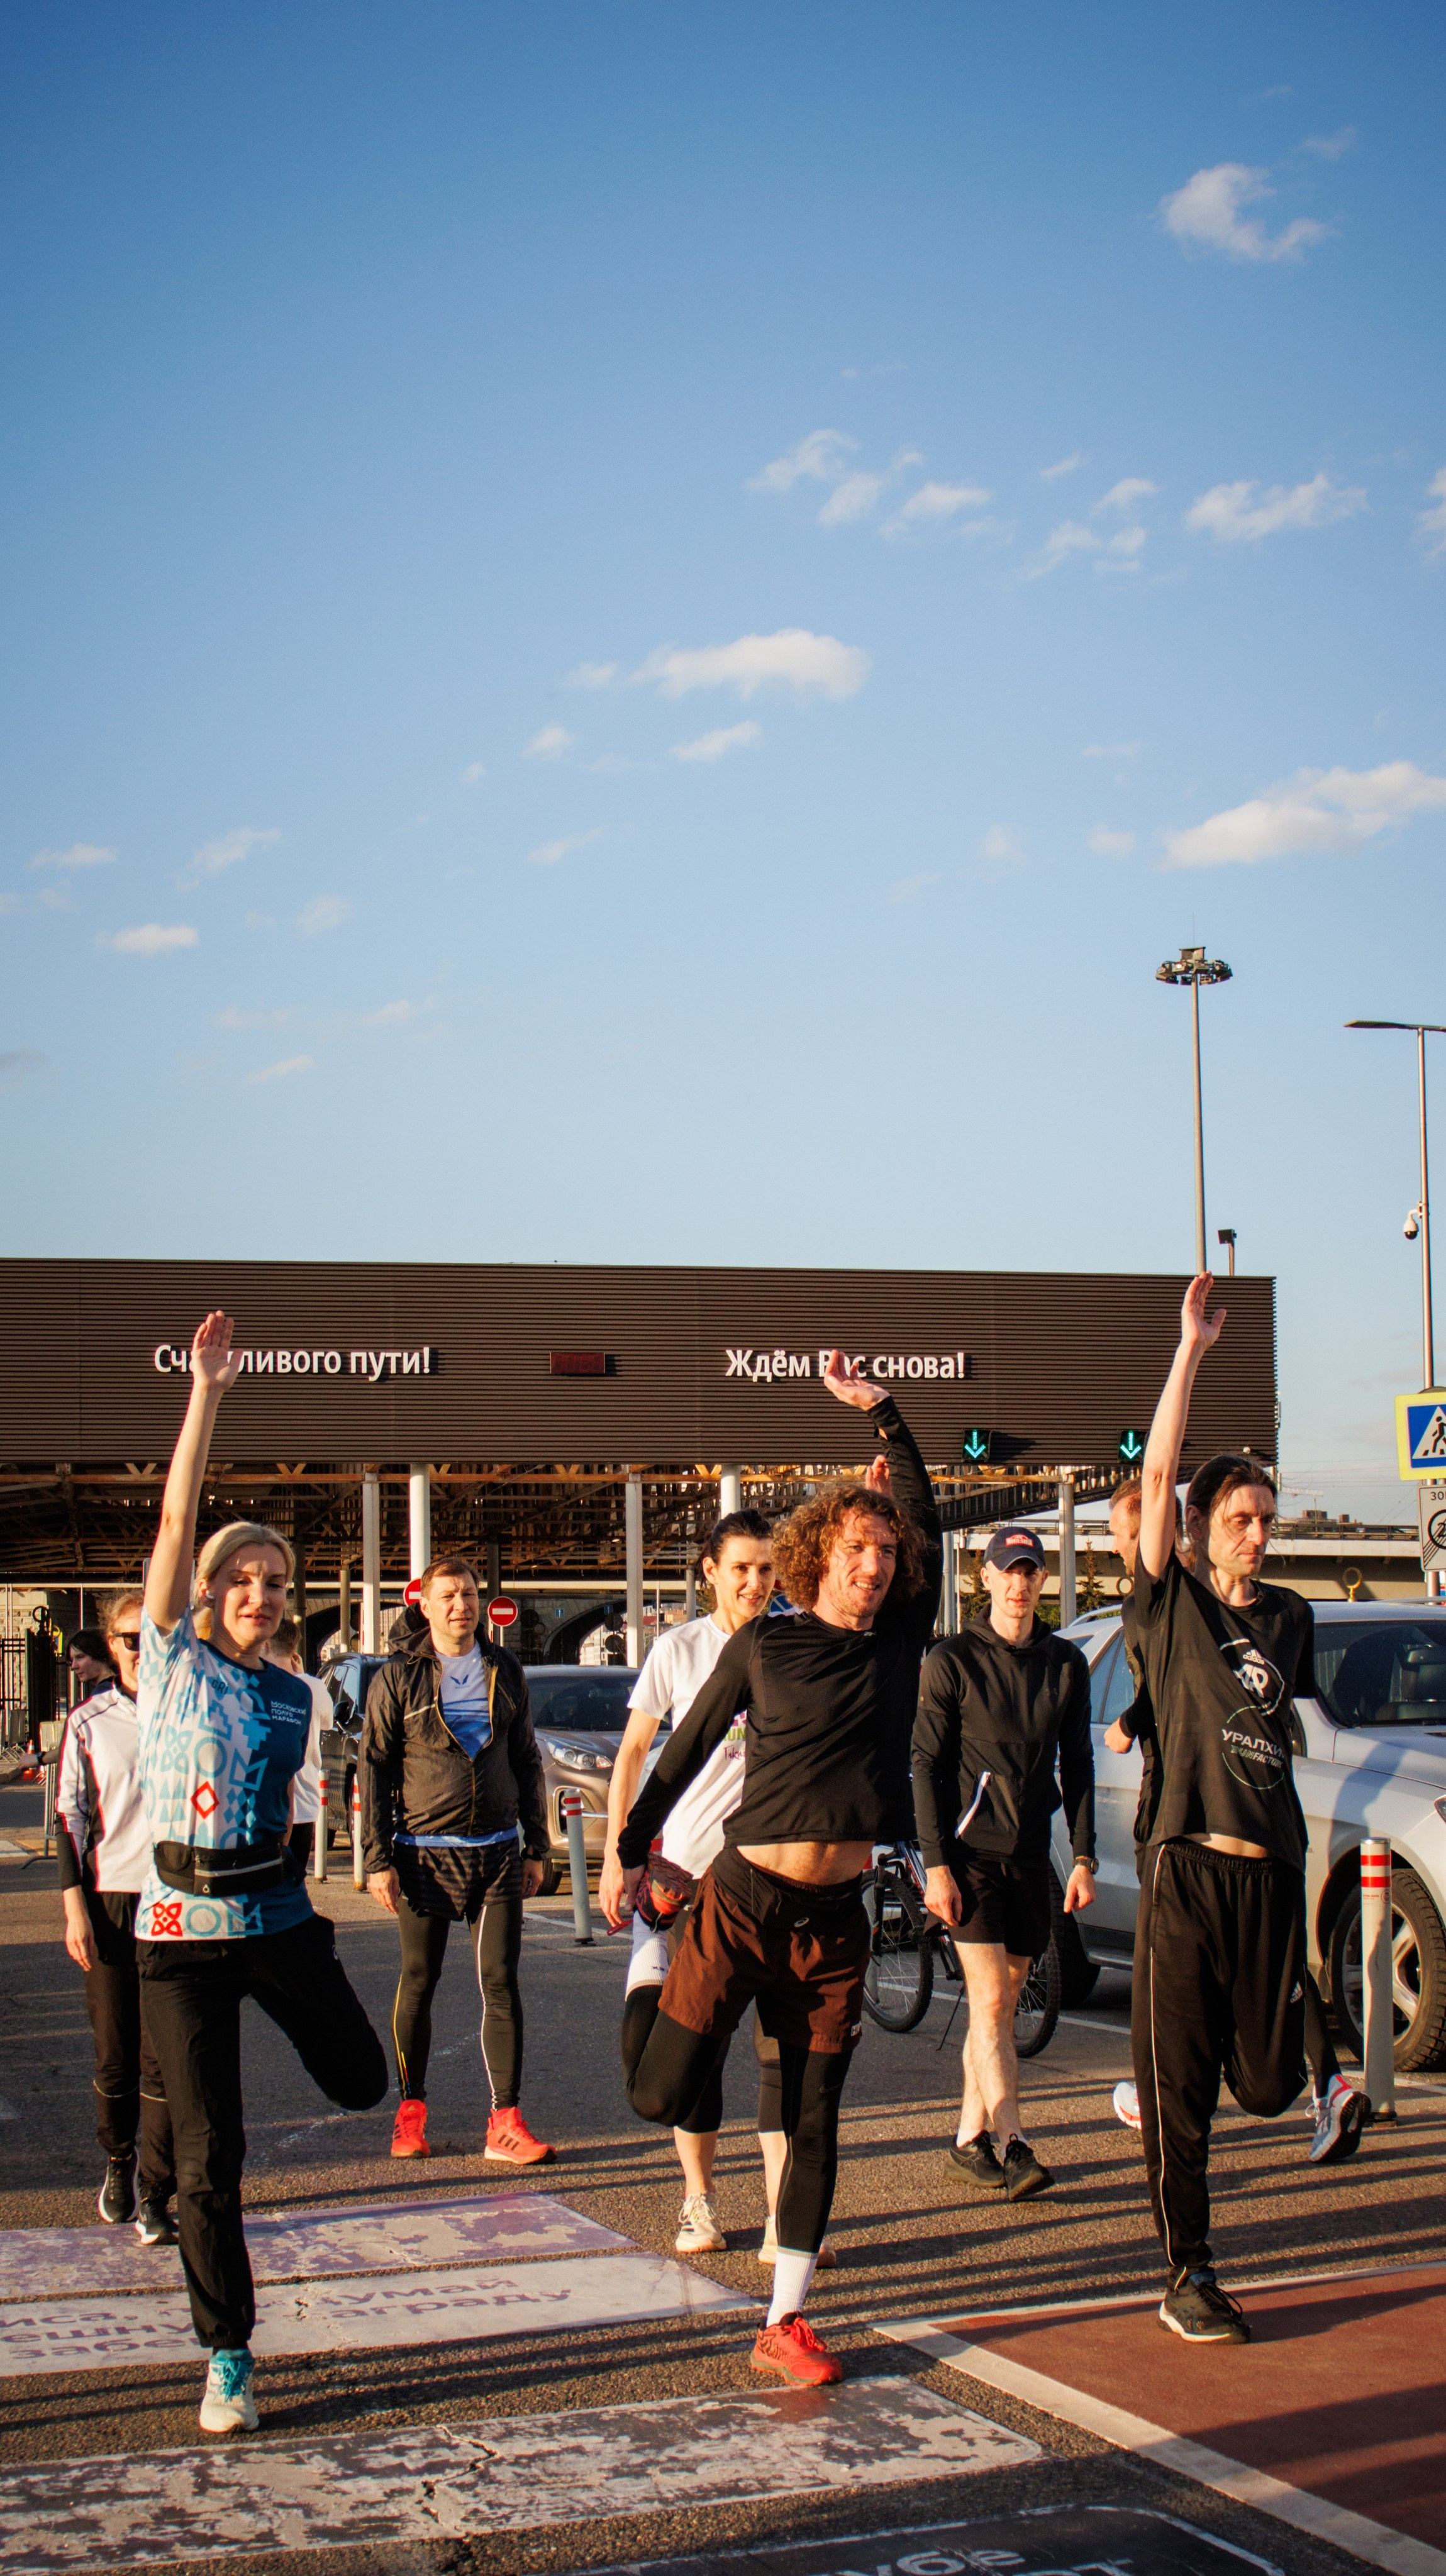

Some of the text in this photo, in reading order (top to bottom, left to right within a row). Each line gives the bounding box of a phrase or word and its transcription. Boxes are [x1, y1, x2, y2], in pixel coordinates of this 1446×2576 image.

[155, 1345, 430, 1381] Счливого пути!
[725, 1349, 811, 1382] Ждём
[873, 1352, 965, 1379] снова!
[1242, 1653, 1265, 1665] adidas
[1221, 1729, 1285, 1758] УРАЛХИ
[8, 2338, 202, 2359] забе
